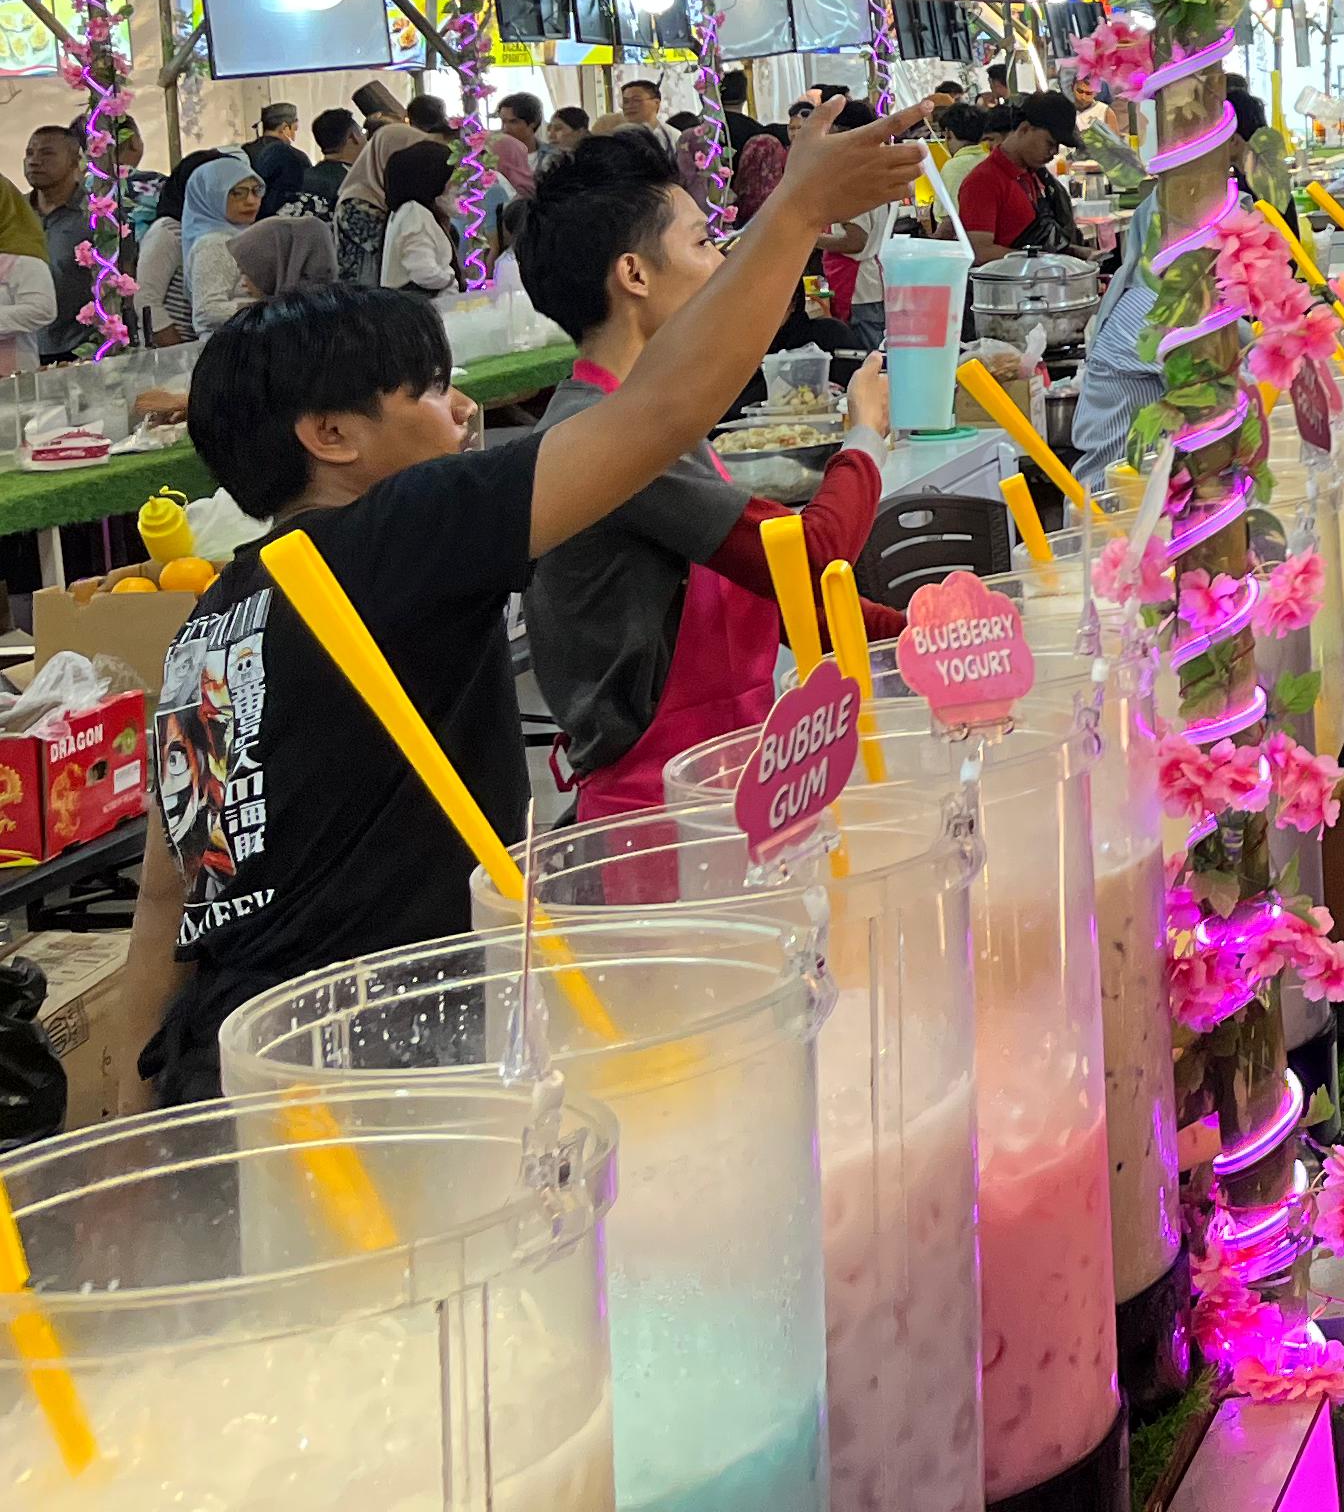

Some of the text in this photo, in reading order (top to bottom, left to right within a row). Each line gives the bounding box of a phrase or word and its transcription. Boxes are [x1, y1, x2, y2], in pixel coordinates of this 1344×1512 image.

[911, 613, 1015, 655] BLUEBERRY
[935, 648, 1012, 687] YOGURT
[50, 723, 104, 764] DRAGON
[758, 692, 854, 784] BUBBLE
[769, 756, 829, 829] GUM
